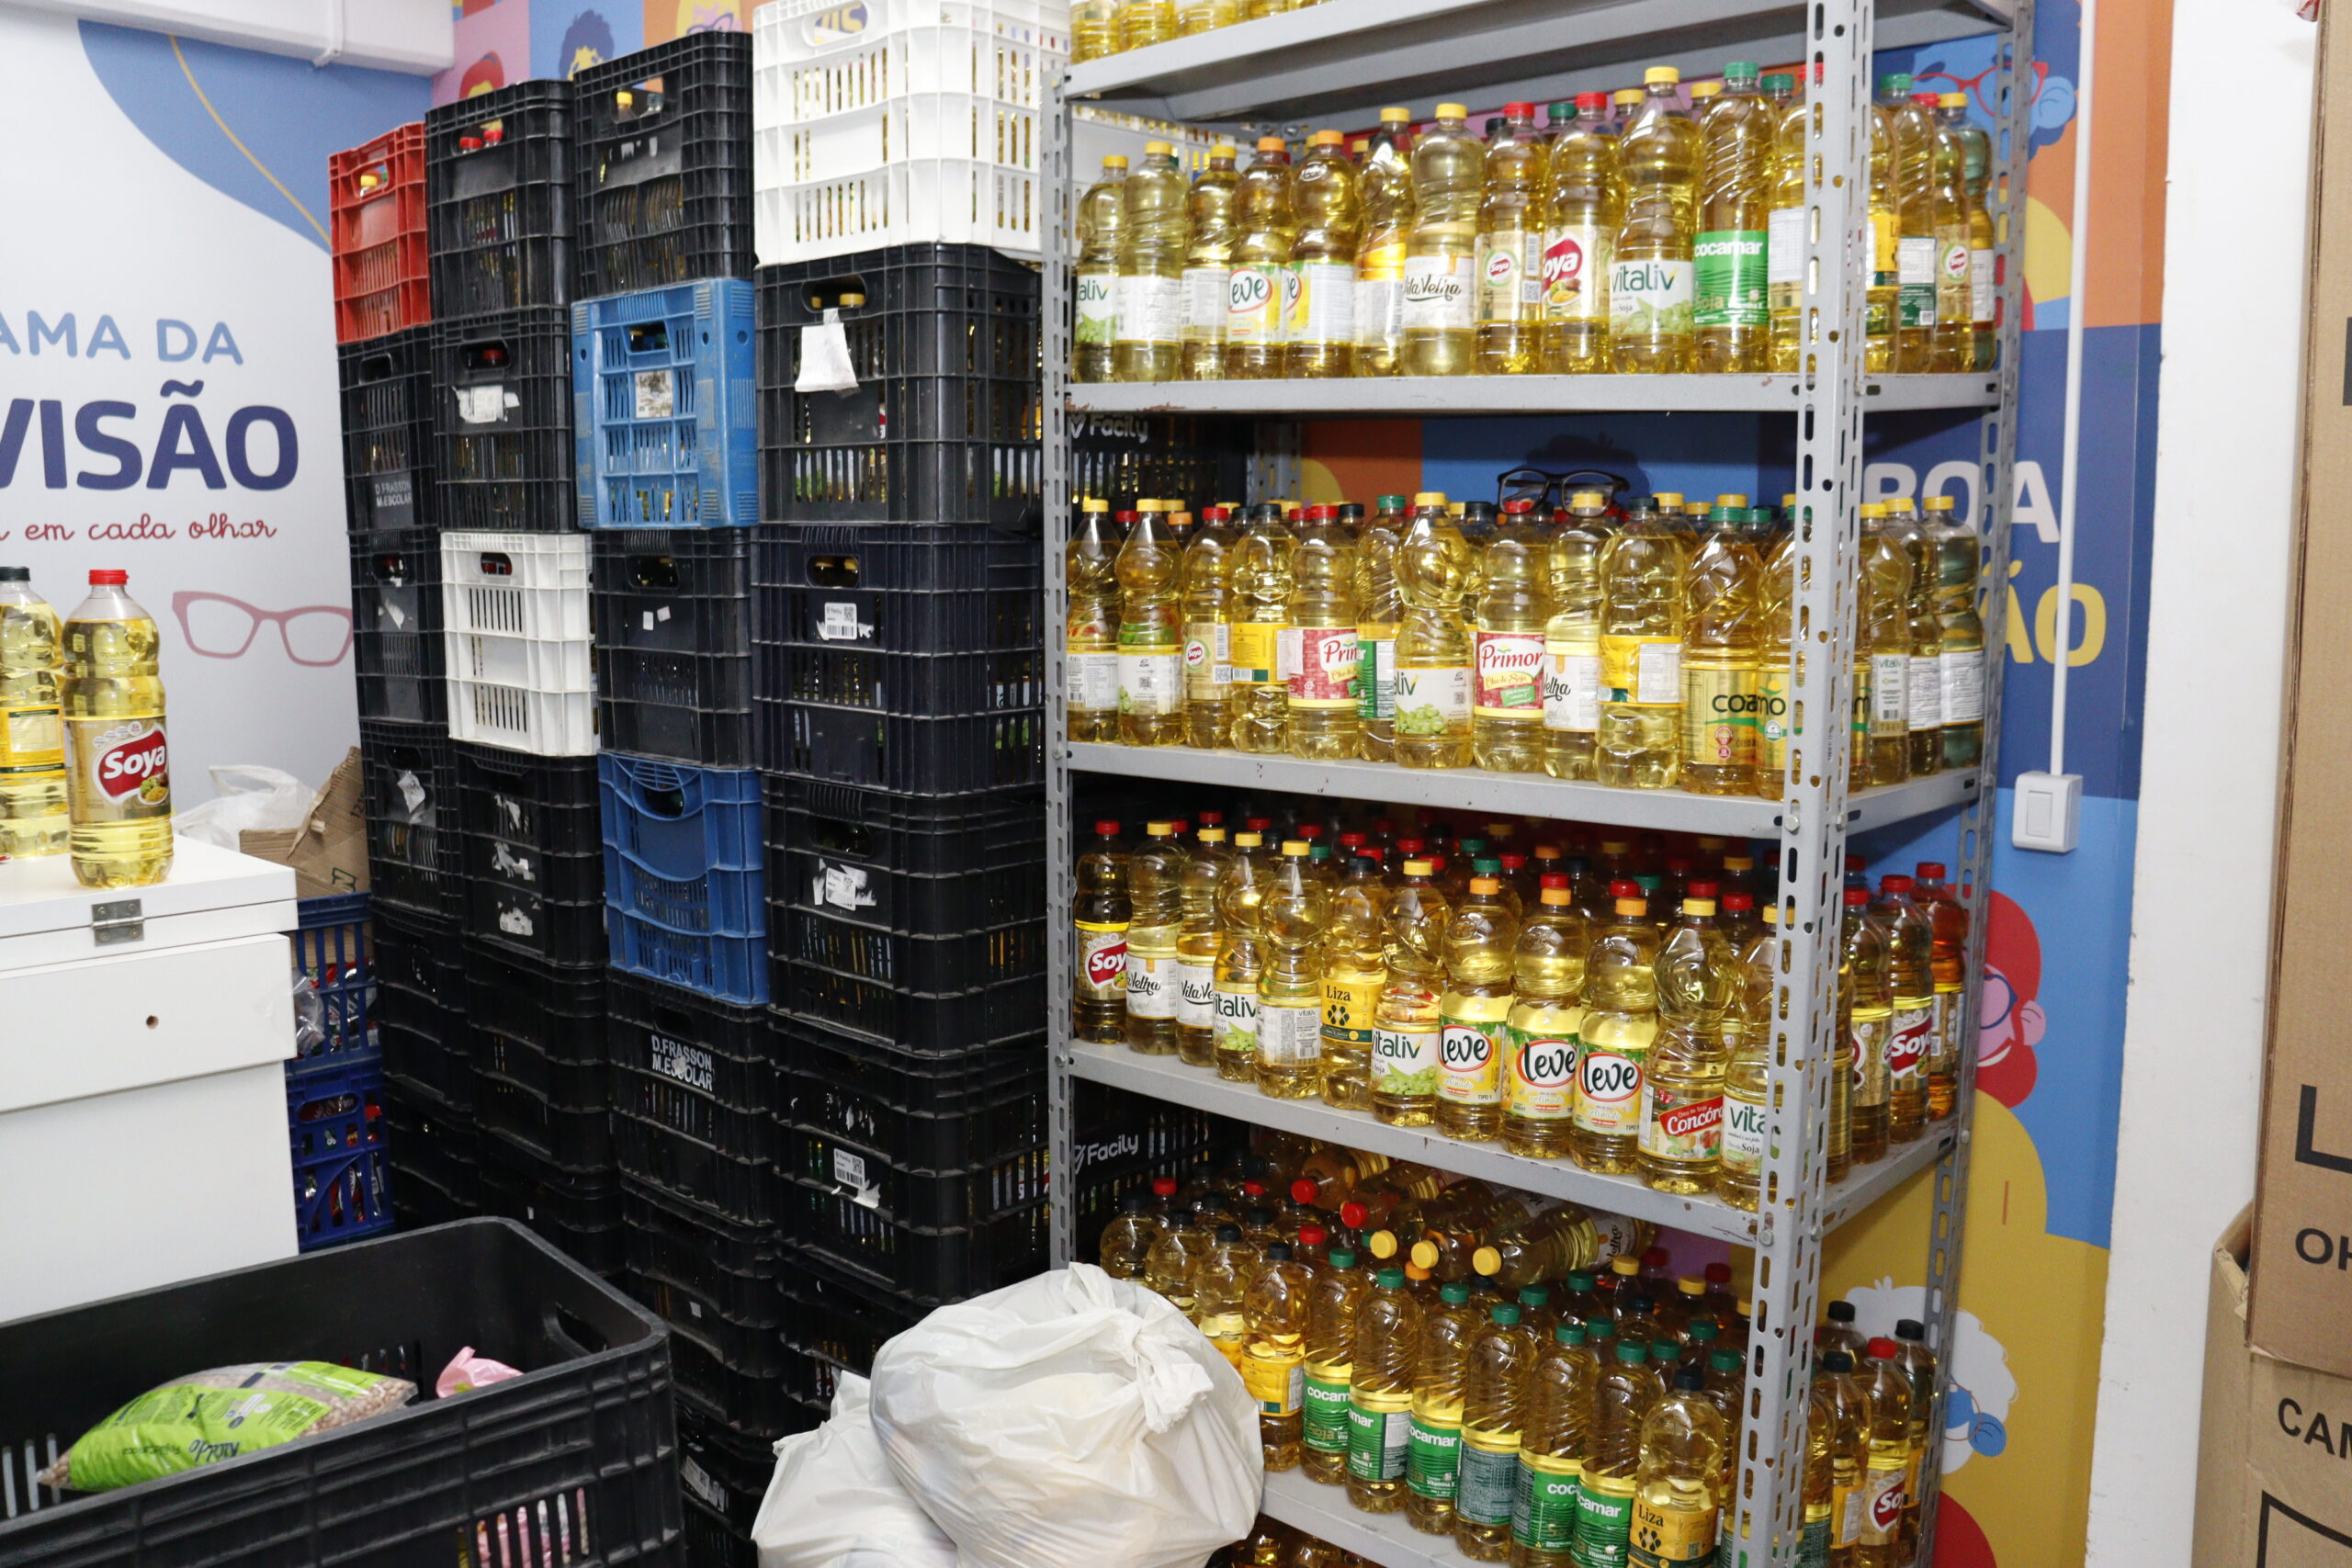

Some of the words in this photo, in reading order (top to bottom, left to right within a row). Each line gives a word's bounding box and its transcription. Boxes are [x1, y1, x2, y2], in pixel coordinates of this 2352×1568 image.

[1544, 252, 1579, 281] oya
[1229, 276, 1267, 304] eve
[156, 318, 244, 366] DA
[25, 521, 75, 542] em
[88, 513, 176, 541] cada
[188, 513, 278, 540] olhar
[1482, 645, 1544, 669] Primor
[103, 745, 165, 779] Soya
[1327, 985, 1351, 1001] Liza
[651, 1034, 712, 1072] D.FRASSON
[1441, 1027, 1487, 1064] leve
[1524, 1043, 1576, 1082] leve
[1584, 1054, 1636, 1094] leve
[1088, 1134, 1138, 1165] Facily
[1742, 1143, 1759, 1155] Soja
[1577, 1497, 1622, 1517] camar
[1638, 1504, 1664, 1528] Liza
